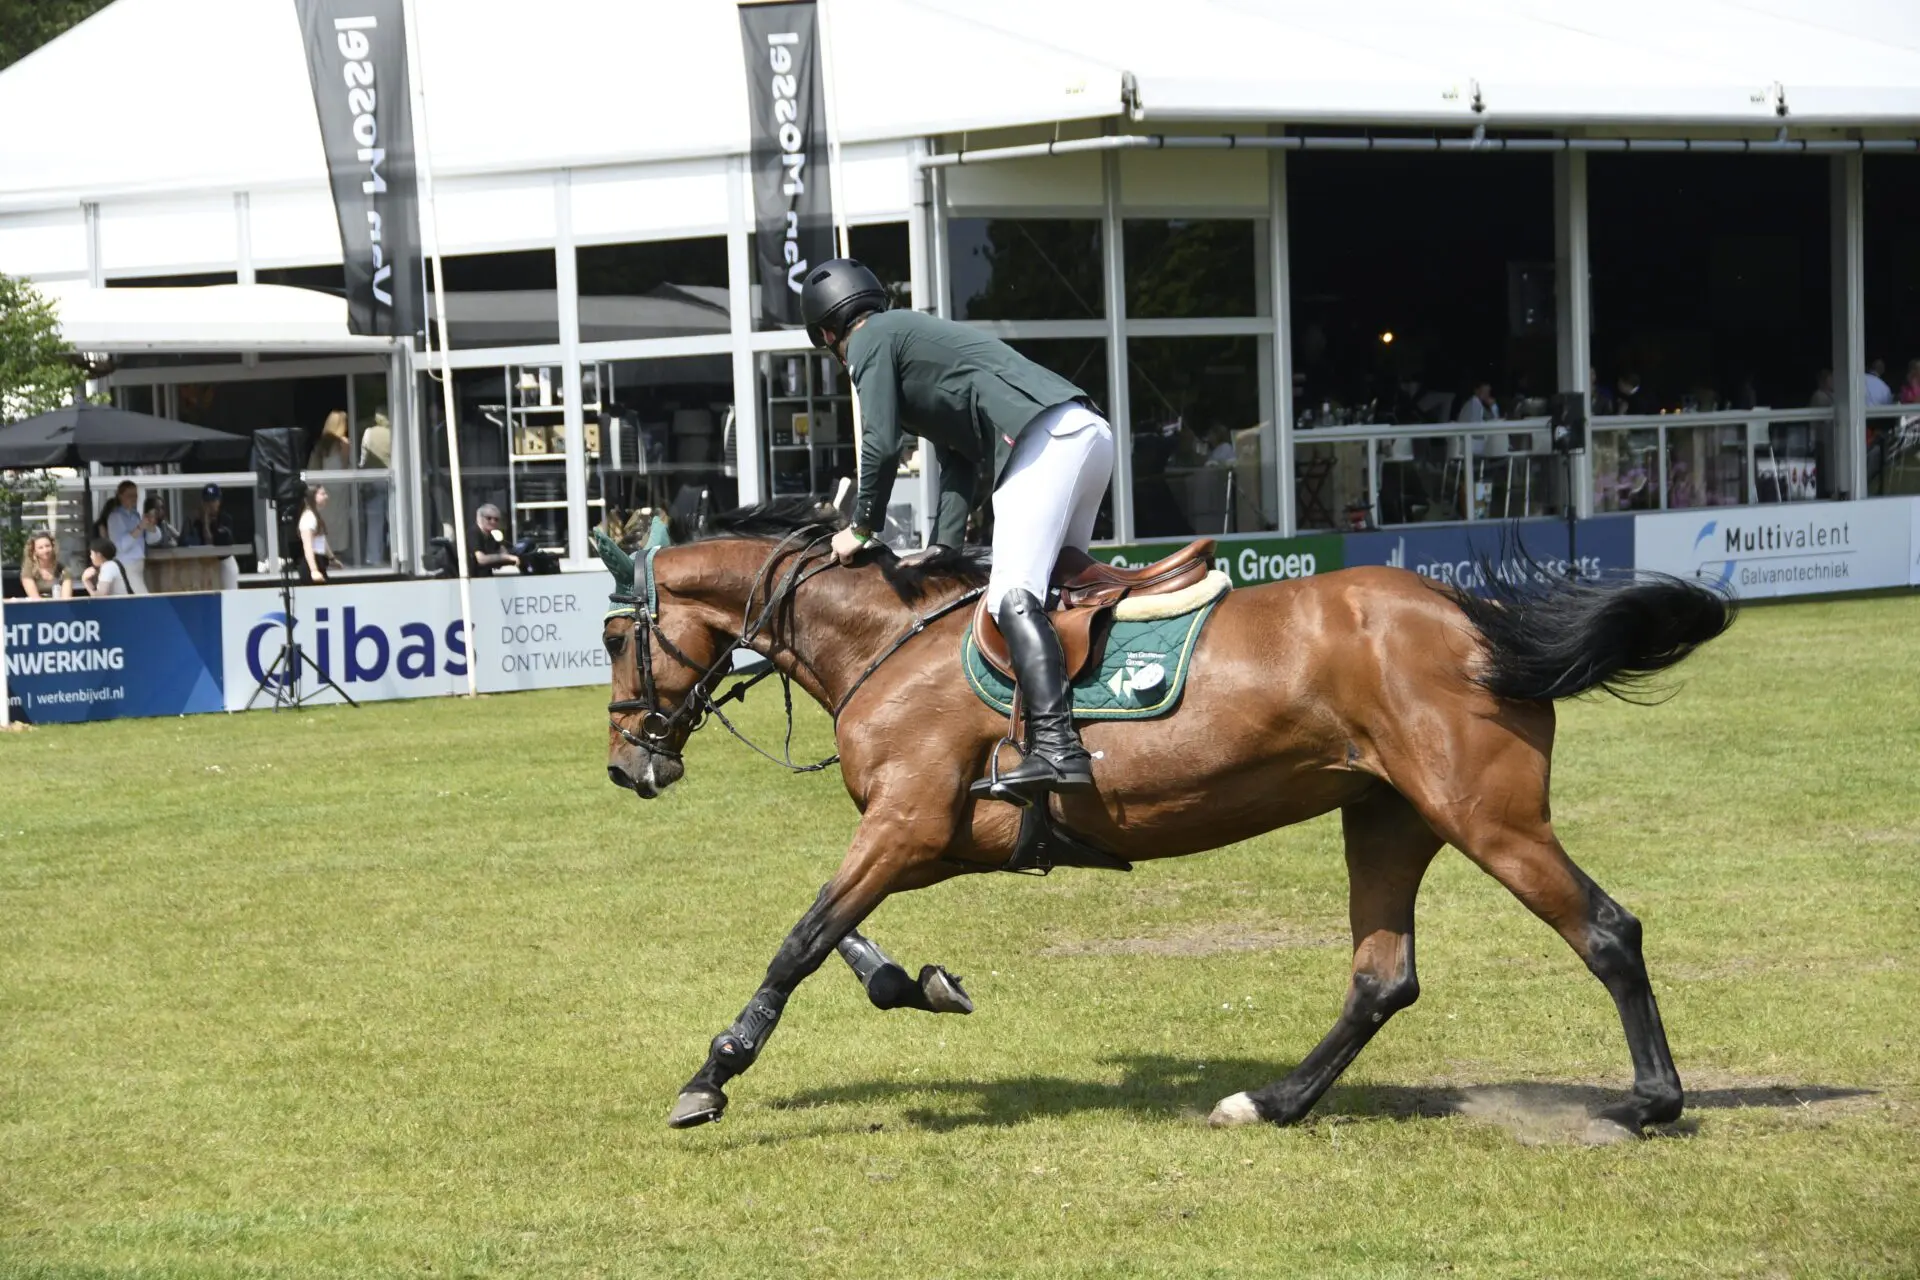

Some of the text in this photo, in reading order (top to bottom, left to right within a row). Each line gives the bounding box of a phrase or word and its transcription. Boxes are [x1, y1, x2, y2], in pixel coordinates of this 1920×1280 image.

[1726, 522, 1849, 552] Multivalent
[1238, 548, 1316, 581] Groep
[1533, 556, 1600, 583] assts
[1741, 561, 1849, 585] Galvanotechniek
[501, 594, 581, 615] VERDER.
[38, 620, 100, 646] DOOR
[502, 624, 562, 644] DOOR.
[37, 686, 124, 704] werkenbijvdl.nl
